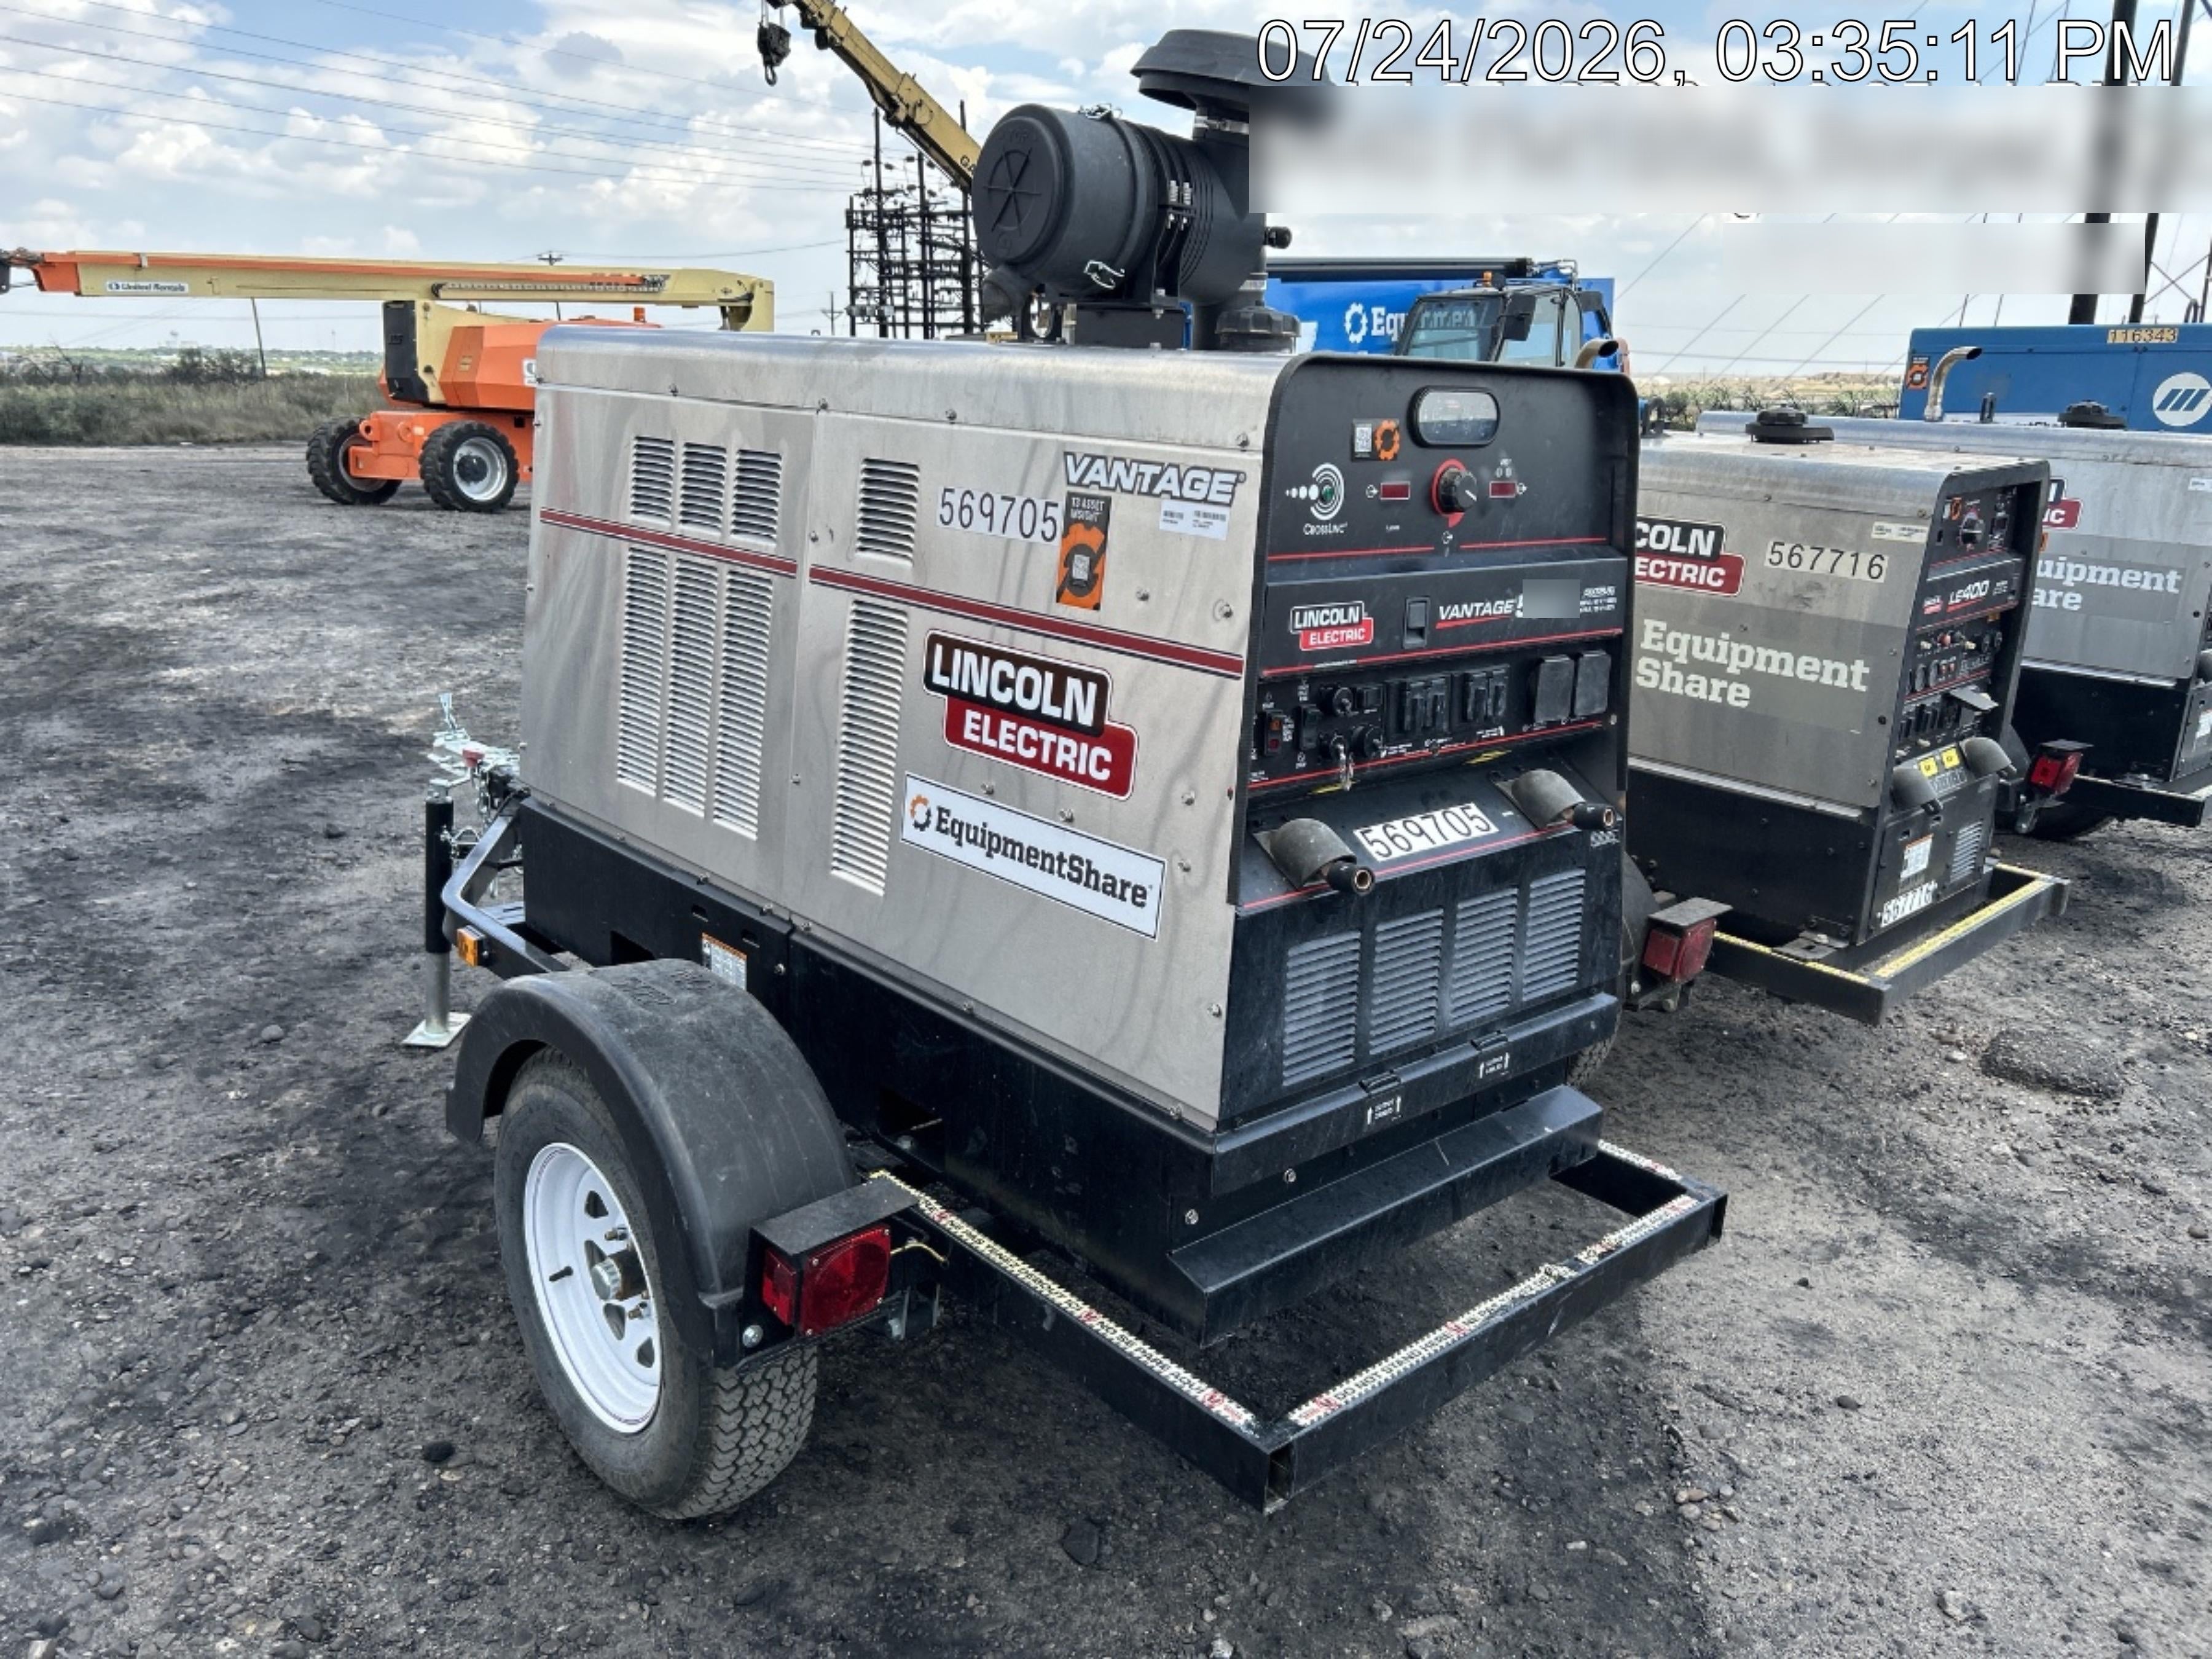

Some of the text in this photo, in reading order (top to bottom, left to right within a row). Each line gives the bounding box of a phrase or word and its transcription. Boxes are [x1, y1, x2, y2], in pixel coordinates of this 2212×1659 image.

[939, 487, 1059, 543] 569705
[1636, 521, 1716, 557] COLN
[1635, 557, 1726, 587] ECTRIC
[1768, 541, 1885, 579] 567716
[2037, 556, 2183, 594] uipment
[1295, 606, 1360, 629] LINCOLN
[1309, 628, 1366, 646] ELECTRIC
[1641, 619, 1870, 691] Equipment
[932, 643, 1097, 727] LINCOLN
[1636, 656, 1751, 708] Share
[963, 709, 1112, 781] ELECTRIC
[936, 805, 1148, 909] EquipmentShare
[1362, 804, 1492, 859] 569705
